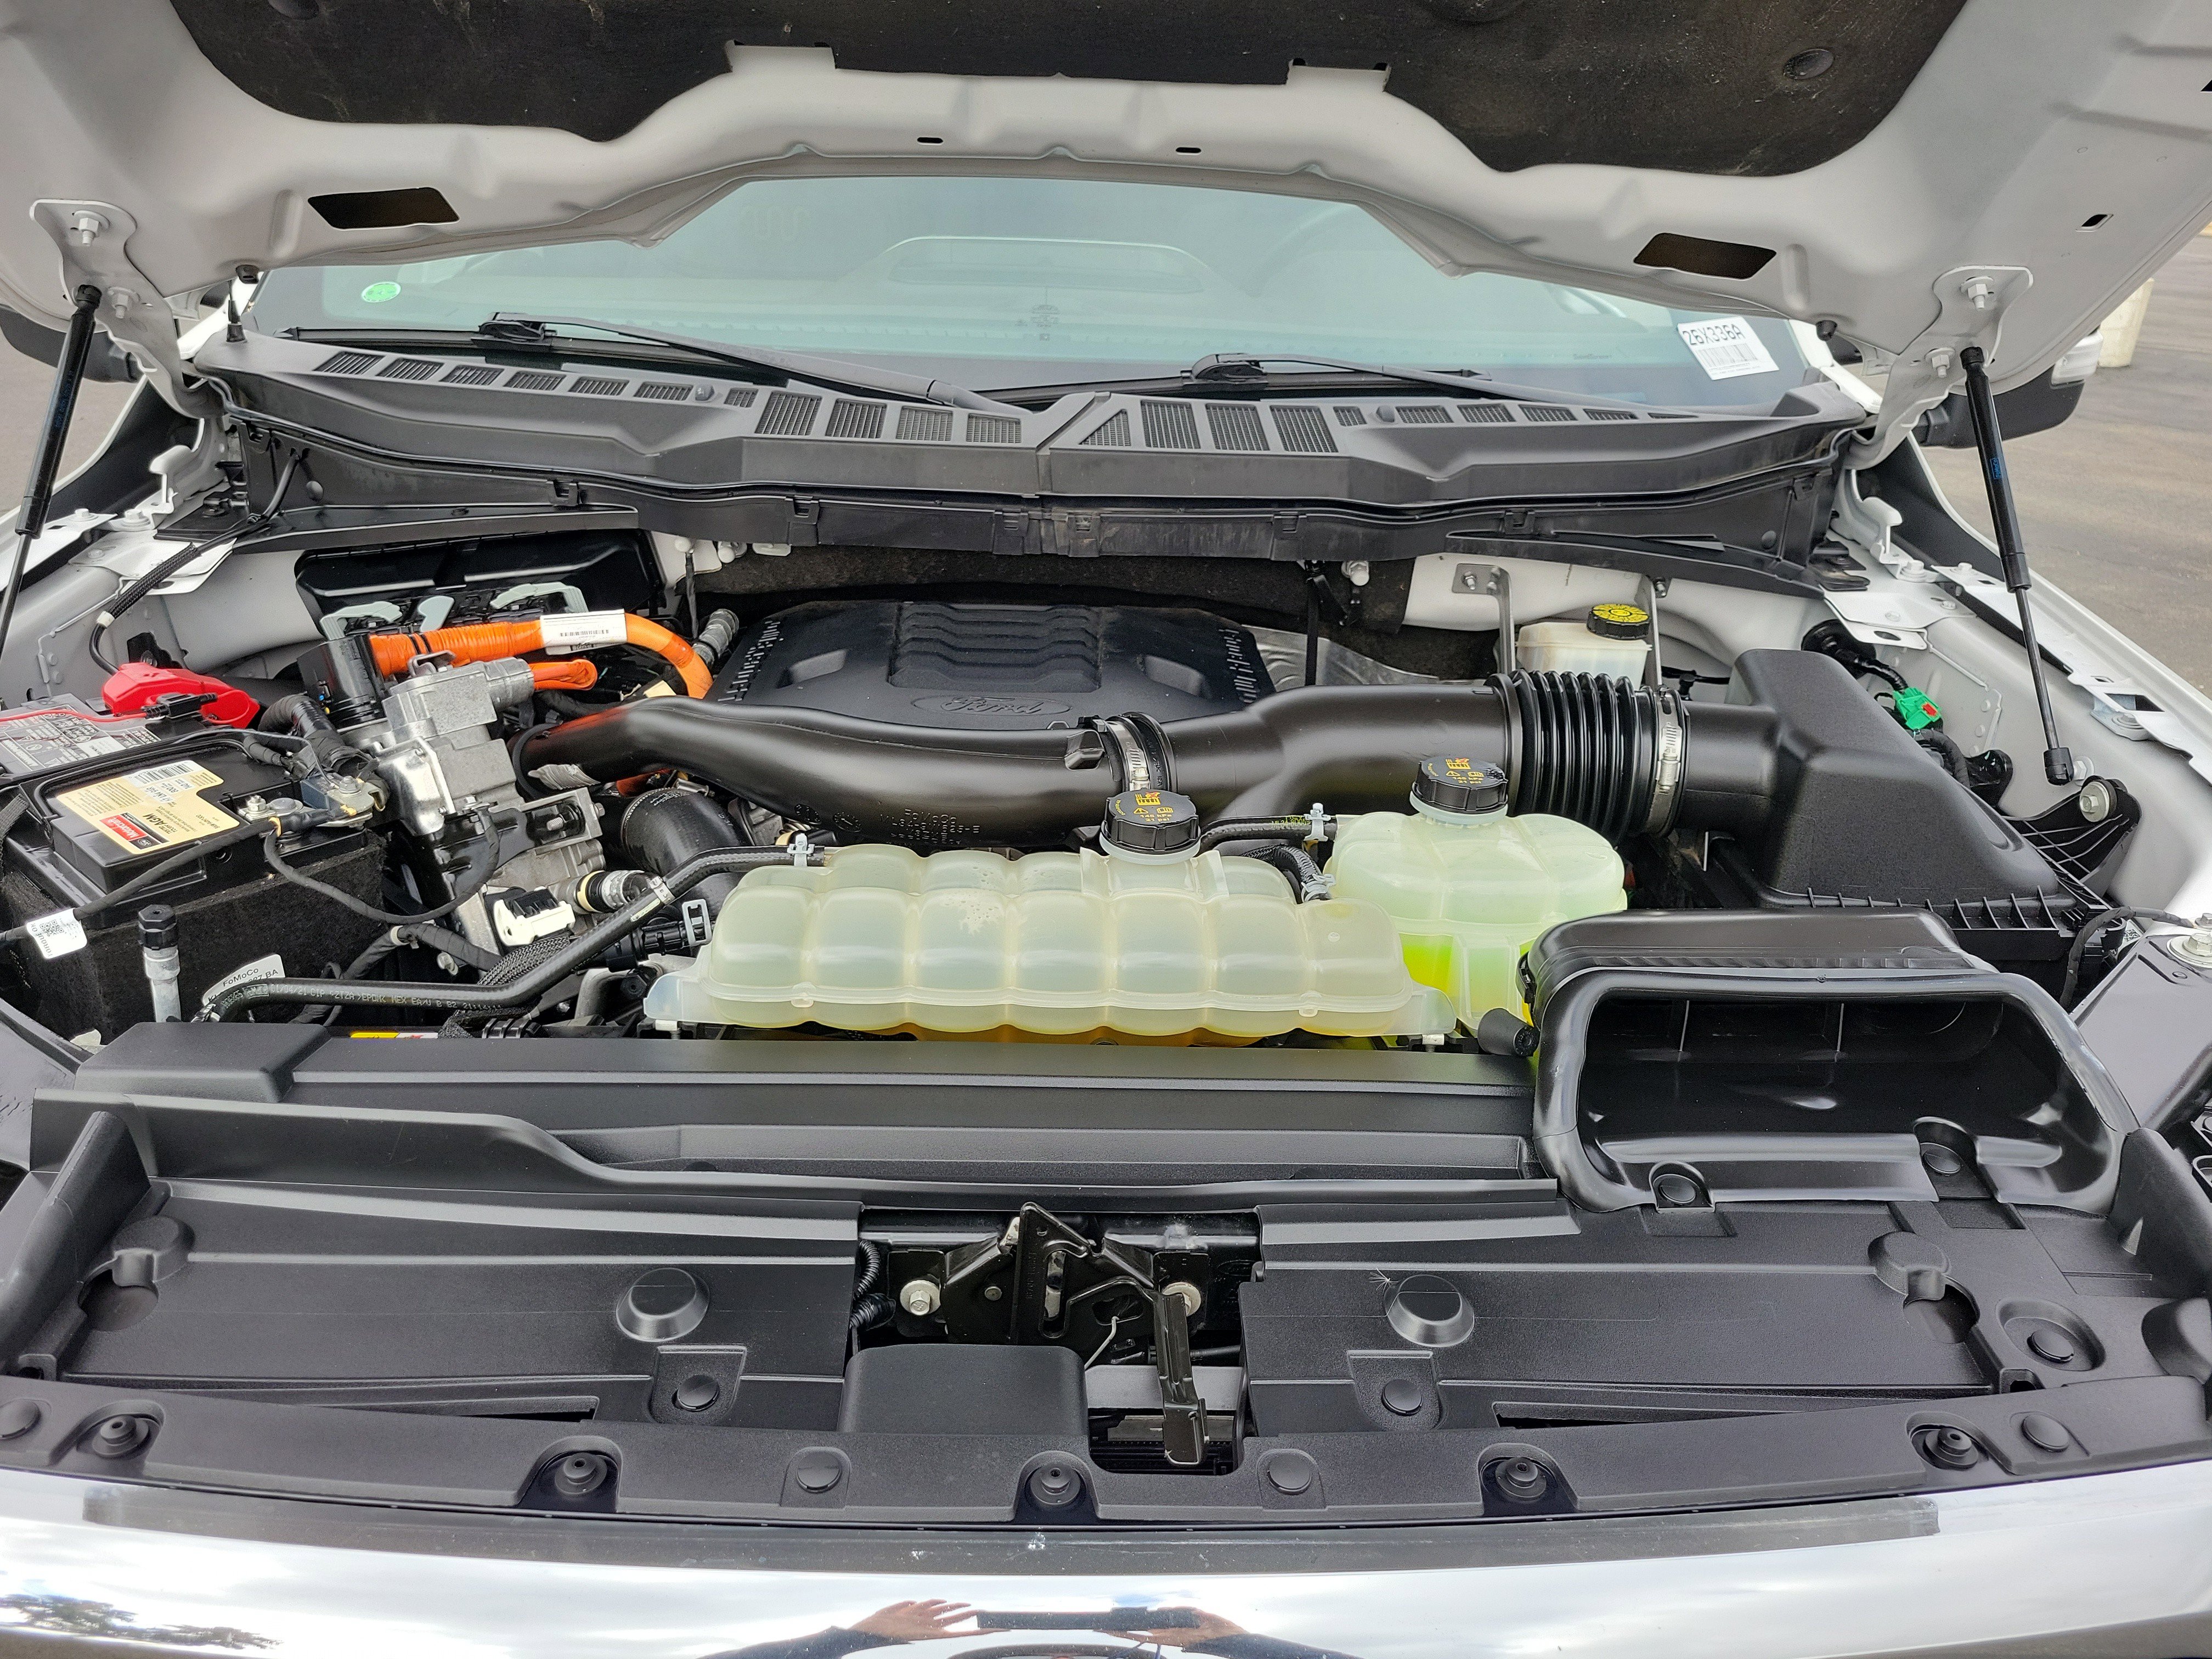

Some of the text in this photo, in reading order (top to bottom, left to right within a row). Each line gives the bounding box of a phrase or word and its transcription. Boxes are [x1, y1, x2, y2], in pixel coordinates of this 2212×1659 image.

[1682, 324, 1746, 346] 26X336A
[940, 697, 1044, 714] Ford
[108, 817, 140, 839] Motorcraft
[142, 813, 168, 825] AGM
[31, 923, 53, 957] TORQUE OK
[223, 968, 259, 987] FoMoCo
[265, 969, 279, 979] BA
